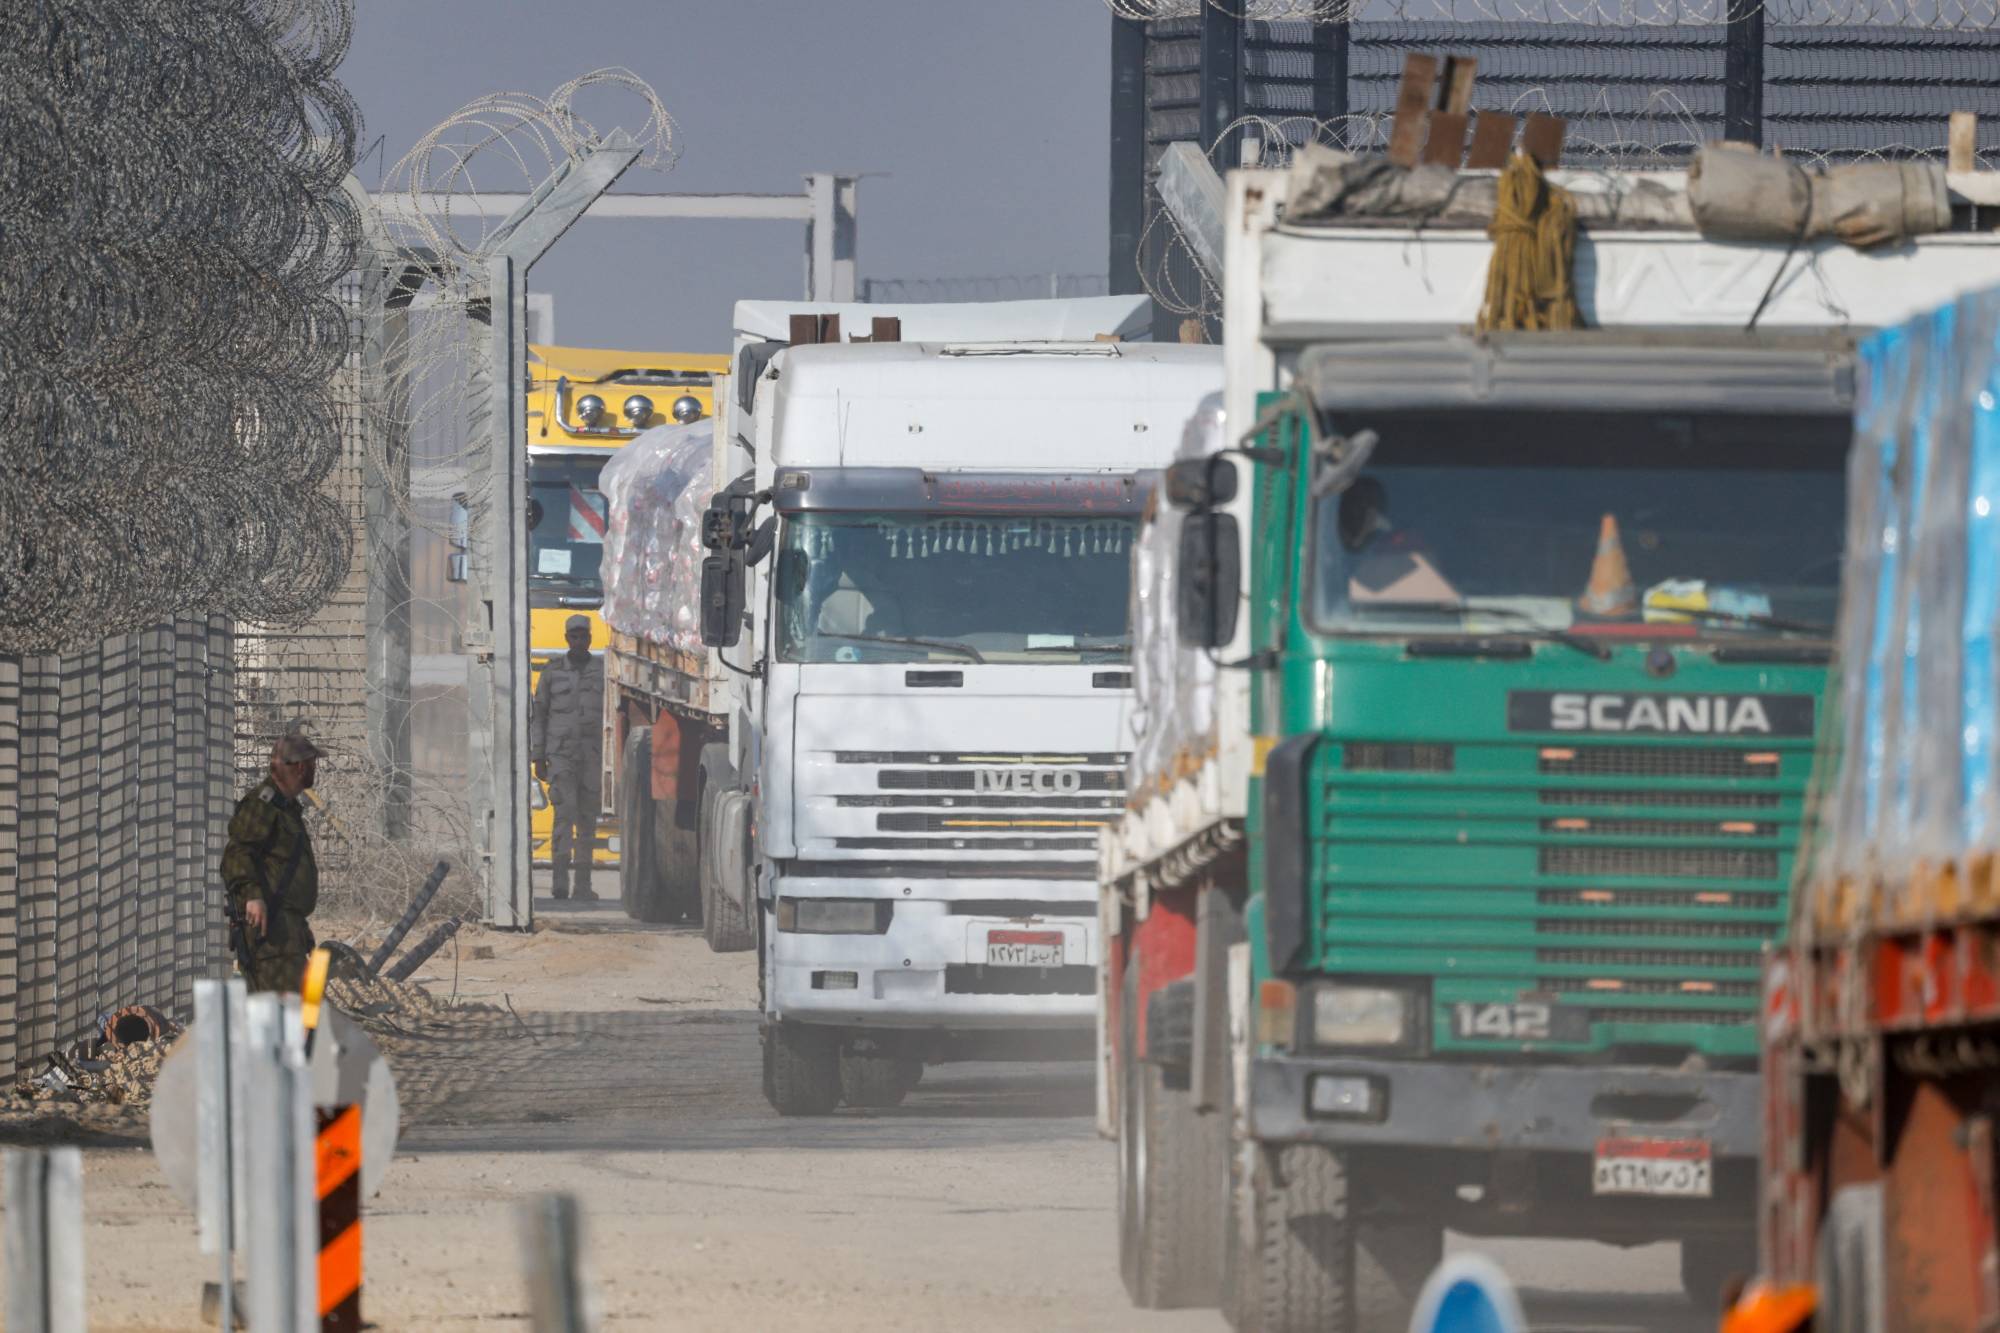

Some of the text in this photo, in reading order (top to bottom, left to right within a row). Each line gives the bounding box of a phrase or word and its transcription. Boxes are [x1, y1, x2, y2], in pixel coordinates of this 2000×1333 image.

[1551, 693, 1771, 733] SCANIA
[974, 769, 1081, 794] IVECO
[1455, 1001, 1550, 1037] 142
